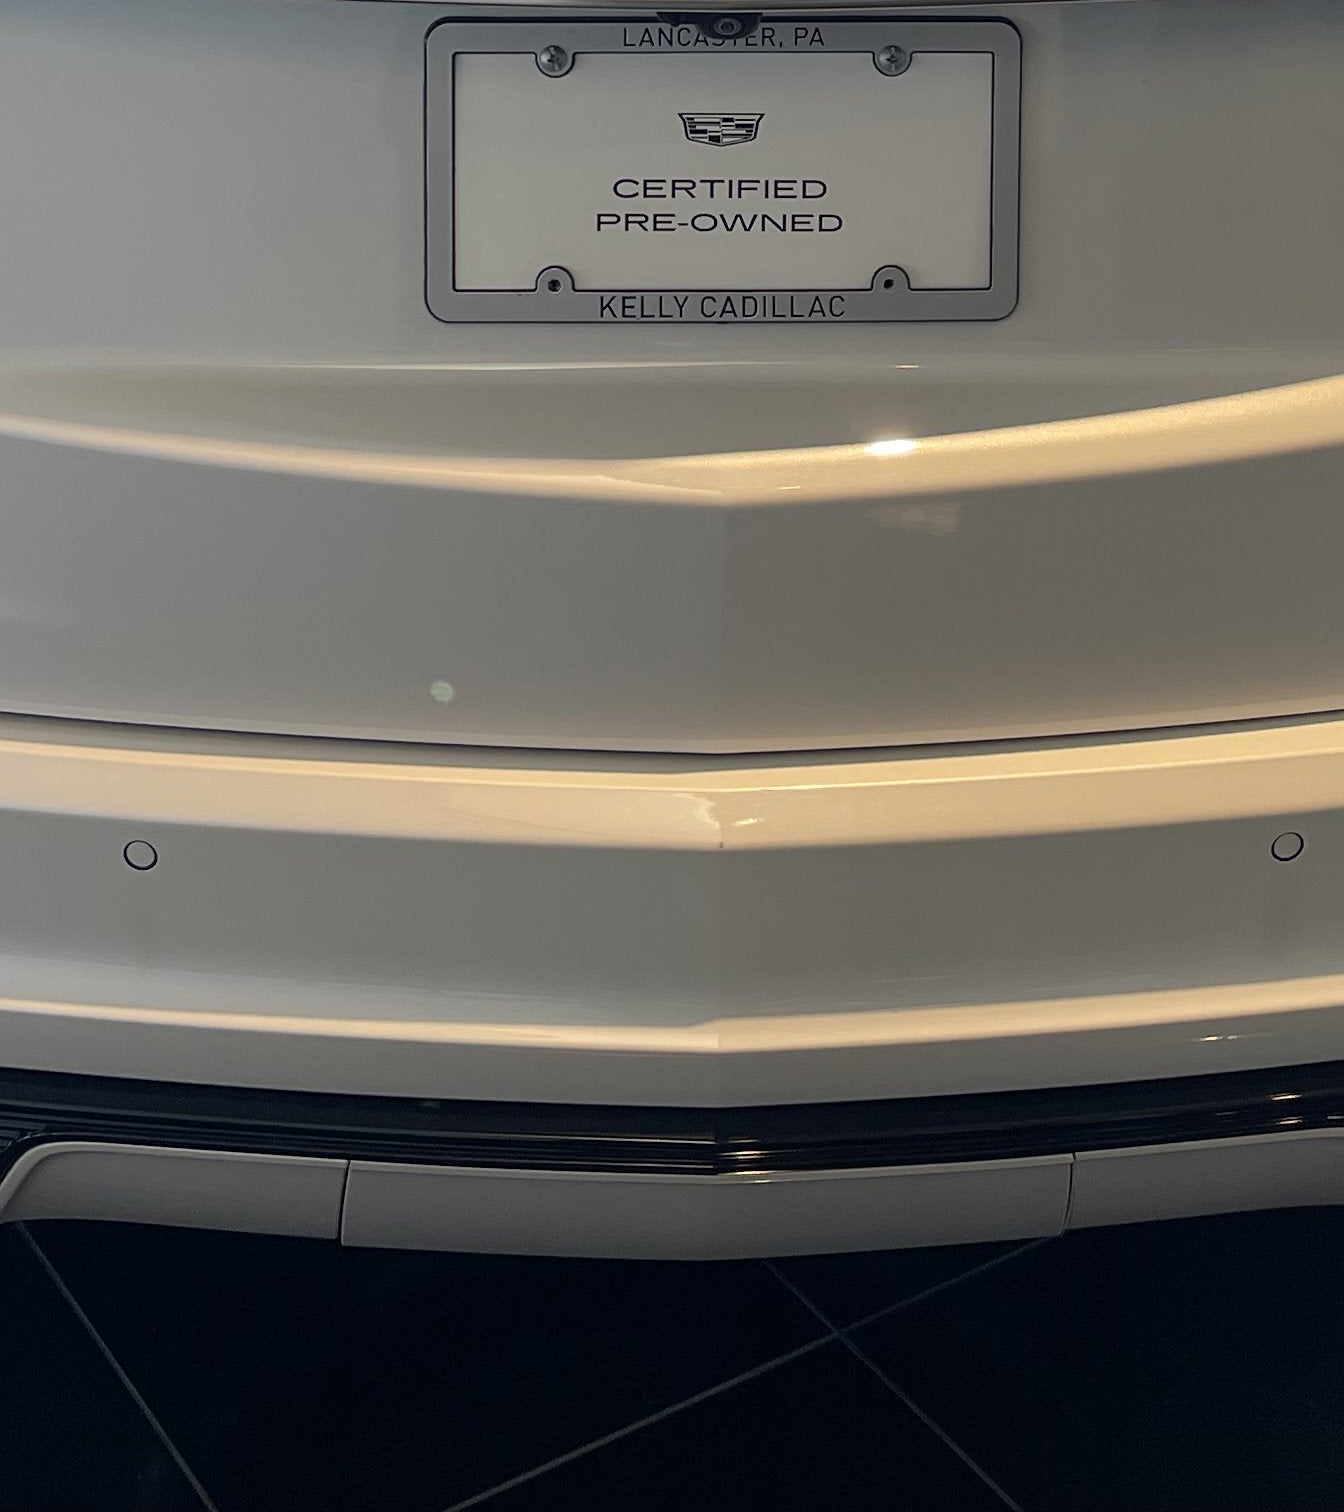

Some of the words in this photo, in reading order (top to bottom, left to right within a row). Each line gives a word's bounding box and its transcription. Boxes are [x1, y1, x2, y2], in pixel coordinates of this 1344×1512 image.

[793, 27, 826, 47] PA
[612, 178, 828, 200] CERTIFIED
[596, 212, 844, 233] PRE-OWNED
[599, 295, 690, 320] KELLY
[699, 294, 846, 319] CADILLAC
